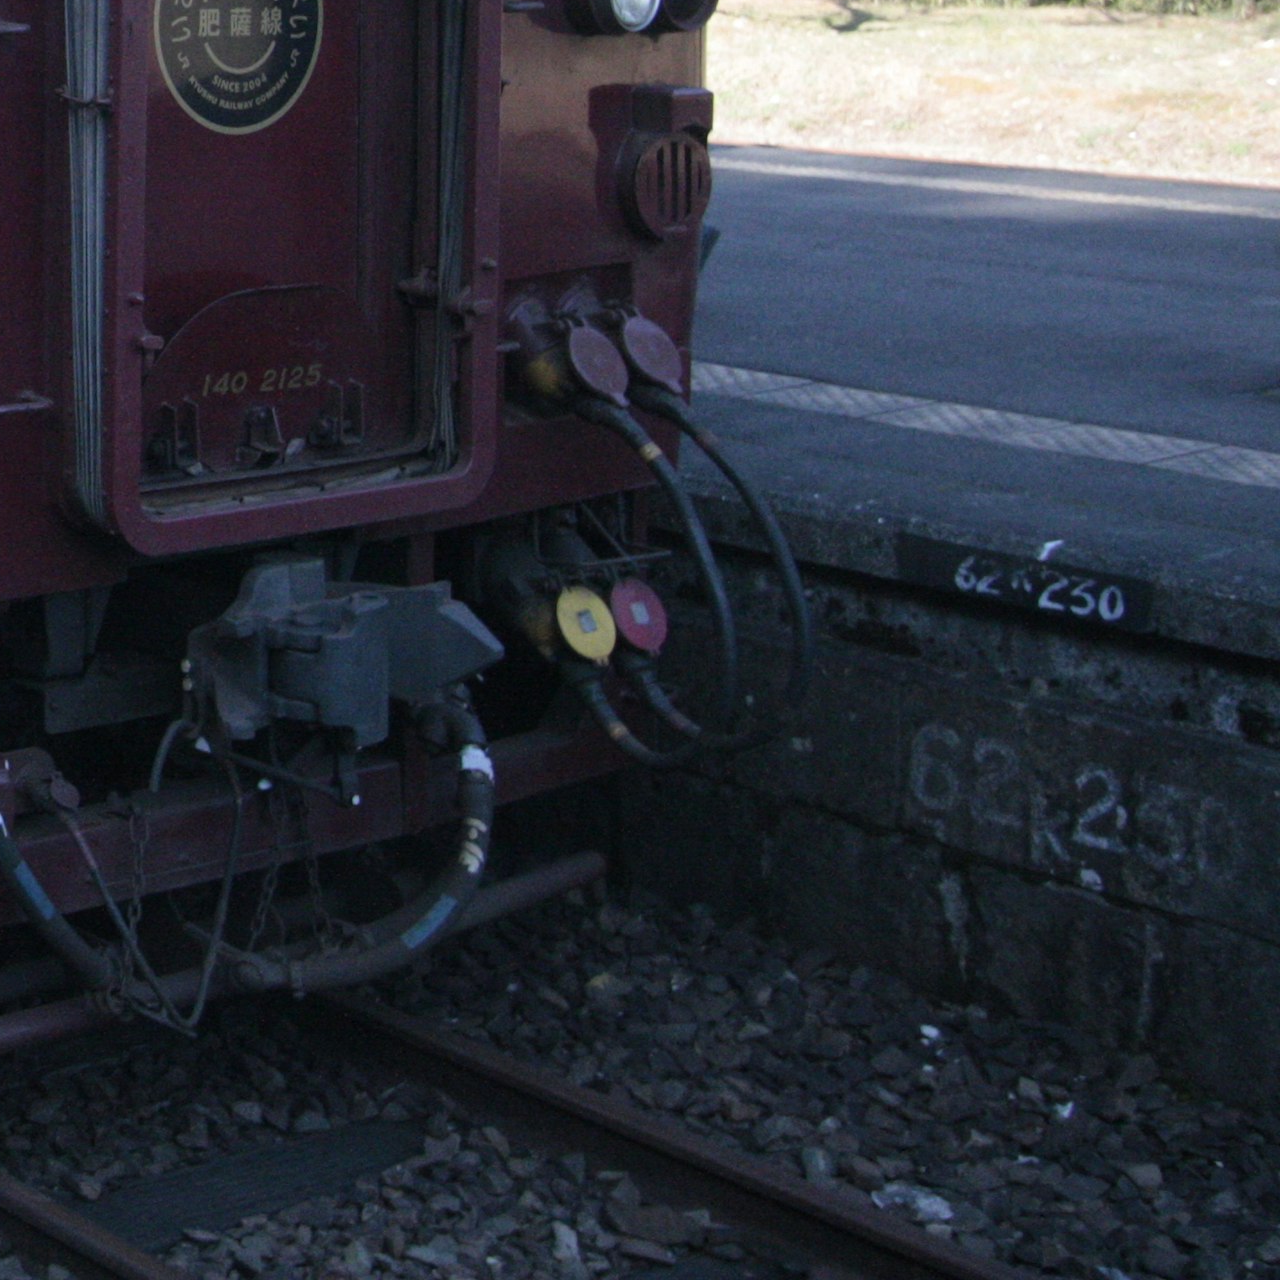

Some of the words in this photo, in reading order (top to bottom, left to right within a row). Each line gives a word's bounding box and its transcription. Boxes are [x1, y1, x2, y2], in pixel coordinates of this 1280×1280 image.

[198, 8, 282, 37] 肥薩線
[189, 75, 219, 105] KYUSHU
[219, 99, 254, 110] RAILWAY
[255, 71, 289, 106] COMPANY
[211, 74, 240, 93] SINCE
[242, 72, 268, 93] 2004
[202, 372, 247, 396] 140
[260, 364, 323, 391] 2125
